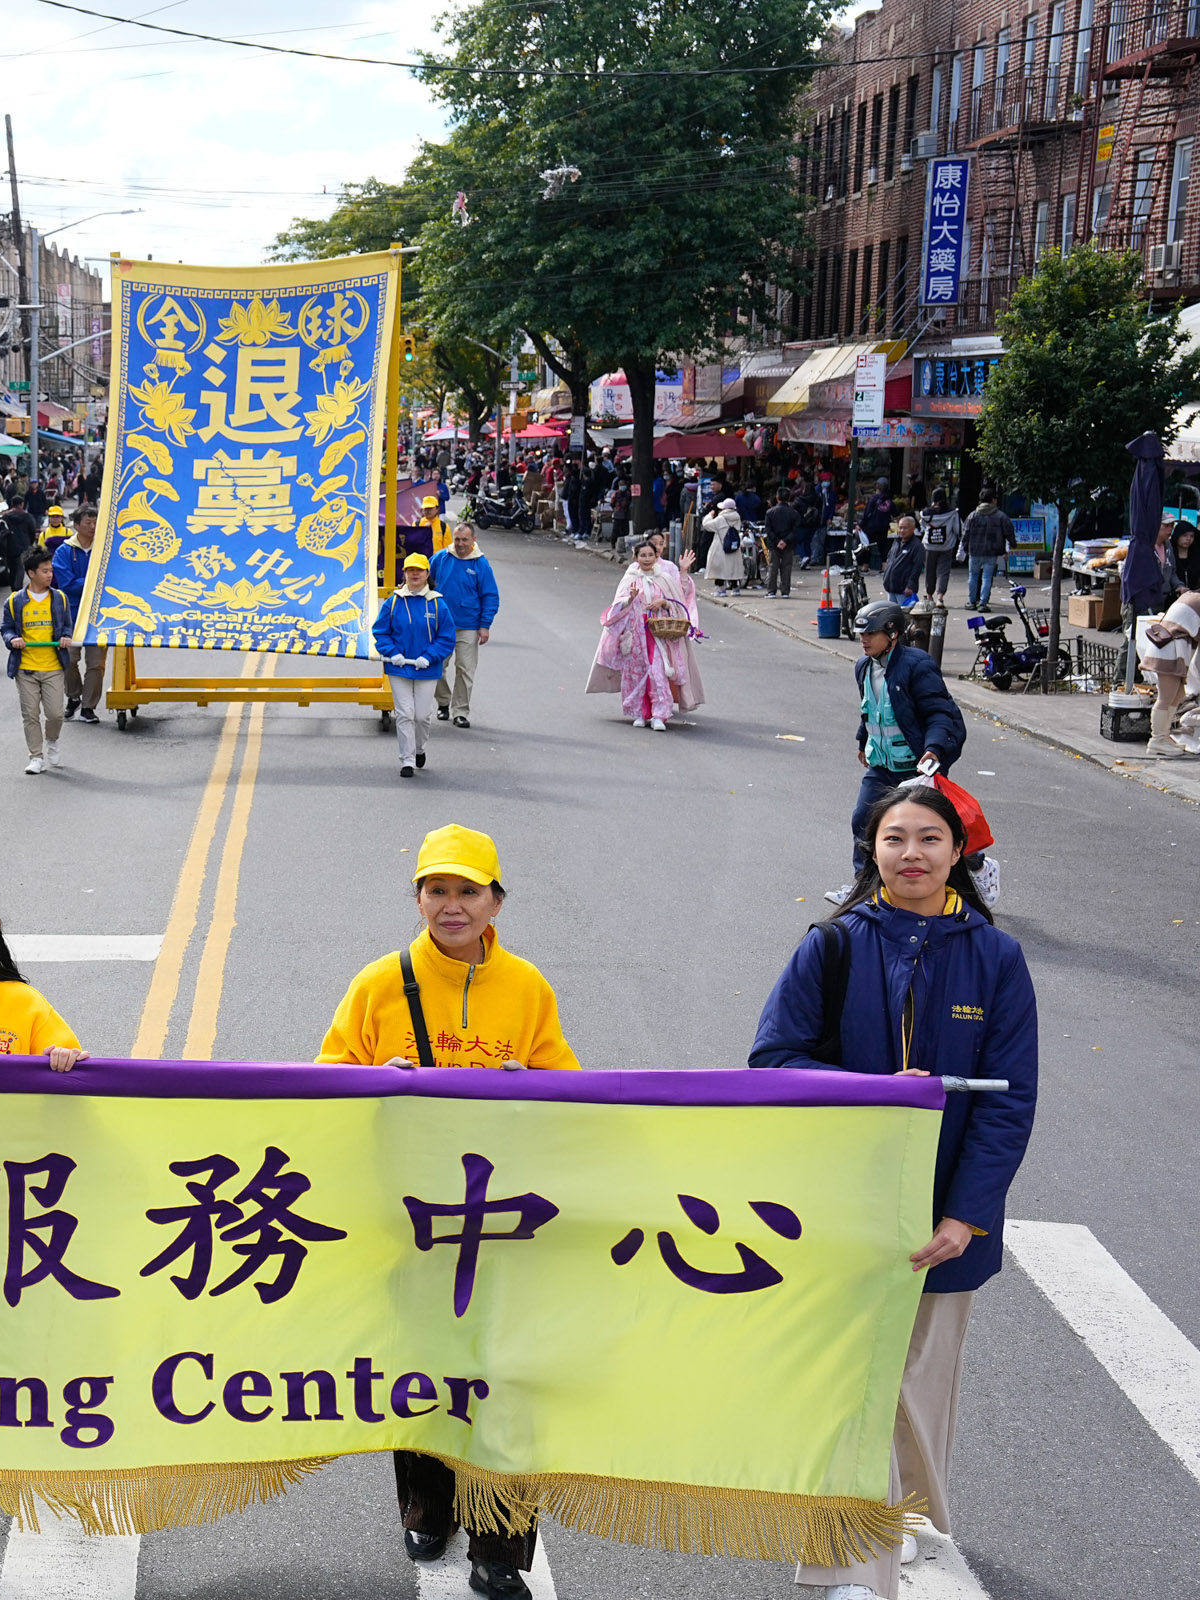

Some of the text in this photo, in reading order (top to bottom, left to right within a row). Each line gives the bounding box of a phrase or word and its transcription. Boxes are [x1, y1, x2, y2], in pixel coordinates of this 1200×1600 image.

[927, 163, 963, 301] 康怡大藥房
[856, 391, 862, 401] 2
[936, 359, 999, 395] 康怡大藥
[186, 342, 305, 536] 退黨
[202, 622, 274, 633] Center
[151, 1351, 490, 1425] Center
